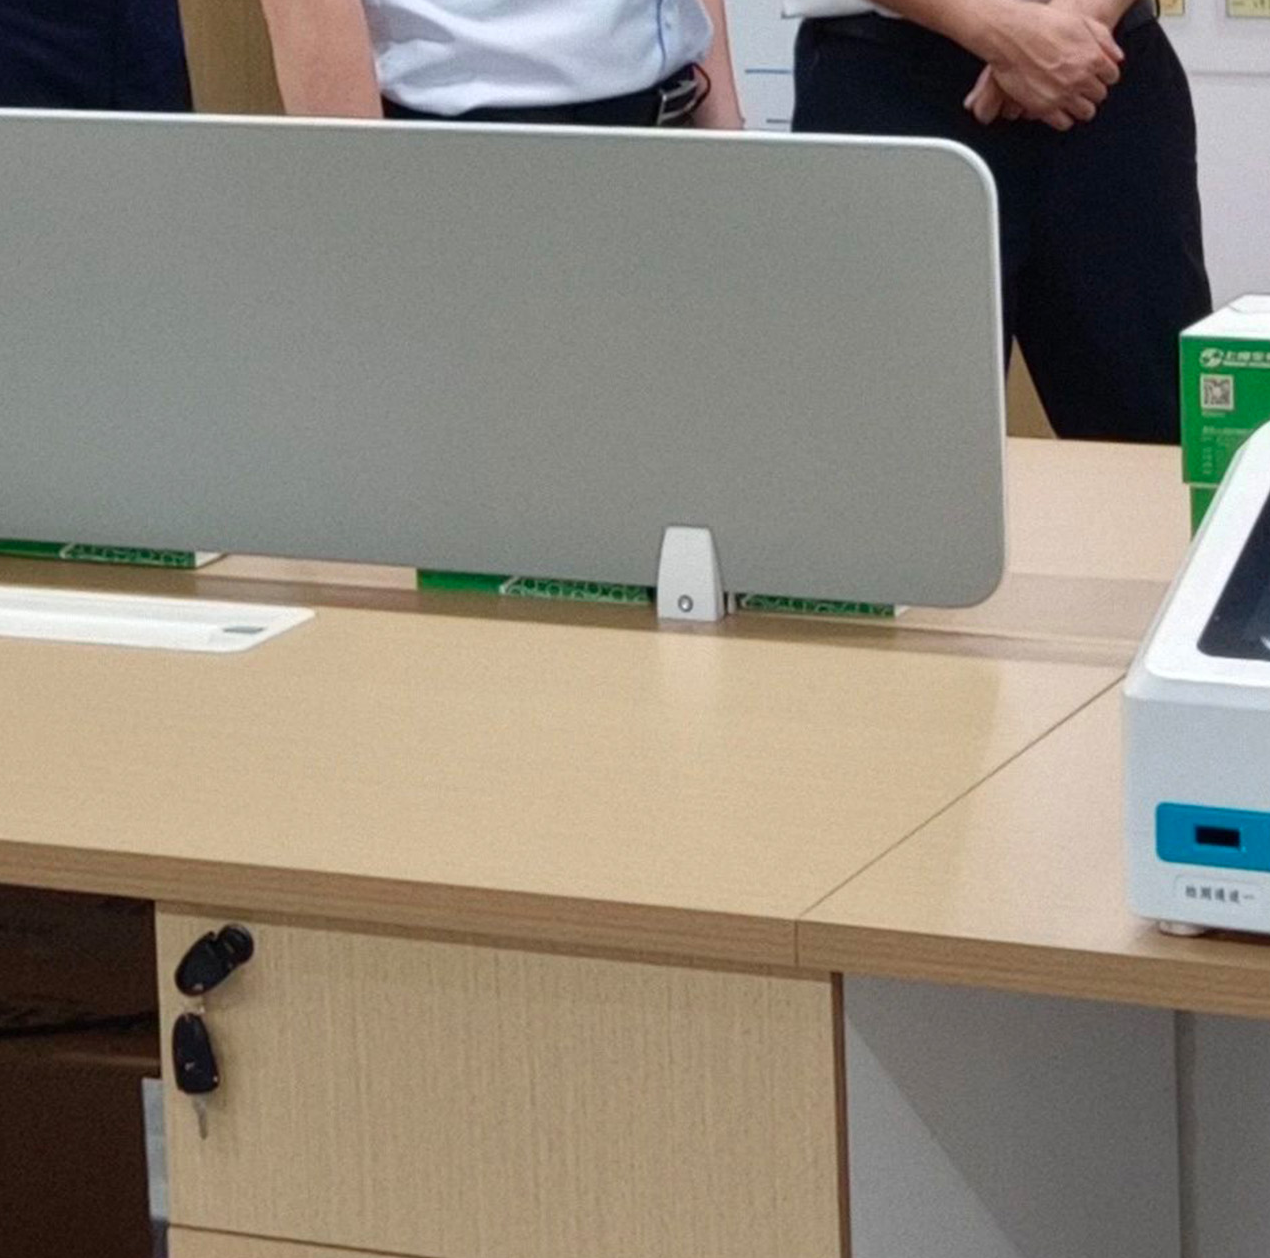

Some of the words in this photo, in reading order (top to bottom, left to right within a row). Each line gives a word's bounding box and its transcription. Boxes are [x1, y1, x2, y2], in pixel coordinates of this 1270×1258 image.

[1185, 884, 1255, 904] 检测通道一
